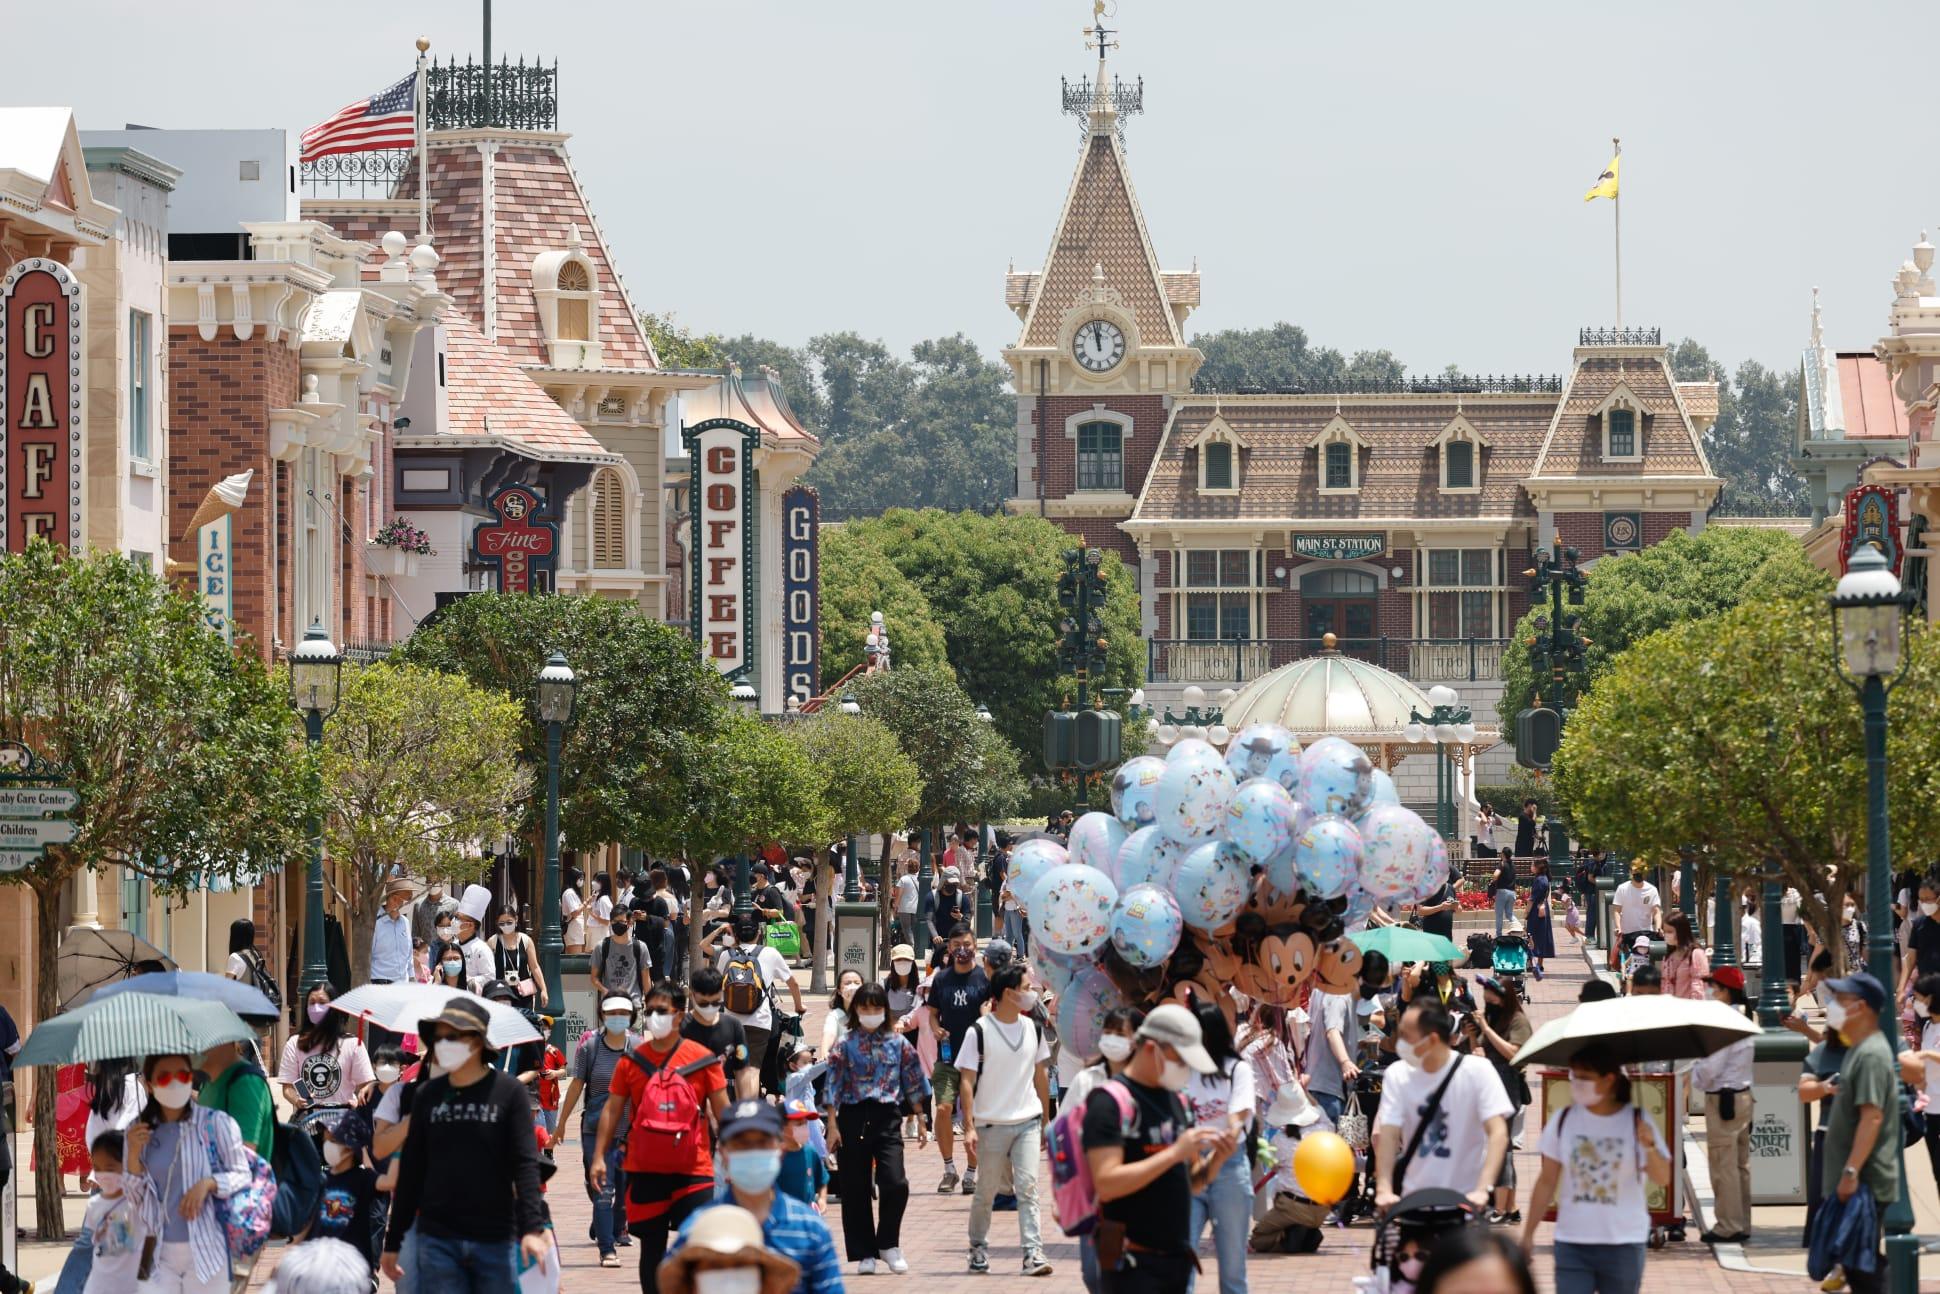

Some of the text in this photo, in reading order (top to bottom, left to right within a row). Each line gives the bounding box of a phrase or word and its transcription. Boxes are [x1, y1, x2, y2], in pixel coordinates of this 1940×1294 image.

[487, 531, 546, 551] Fine
[1297, 539, 1382, 552] MAIN ST. STATION
[707, 446, 737, 659] COFFEE
[205, 530, 224, 595] ICE
[790, 507, 813, 706] GOODS
[17, 793, 36, 804] Care
[39, 793, 67, 805] Center
[0, 824, 38, 836] Children
[1755, 1126, 1785, 1134] MAIN
[1749, 1134, 1791, 1152] STREET
[1760, 1147, 1781, 1157] USA
